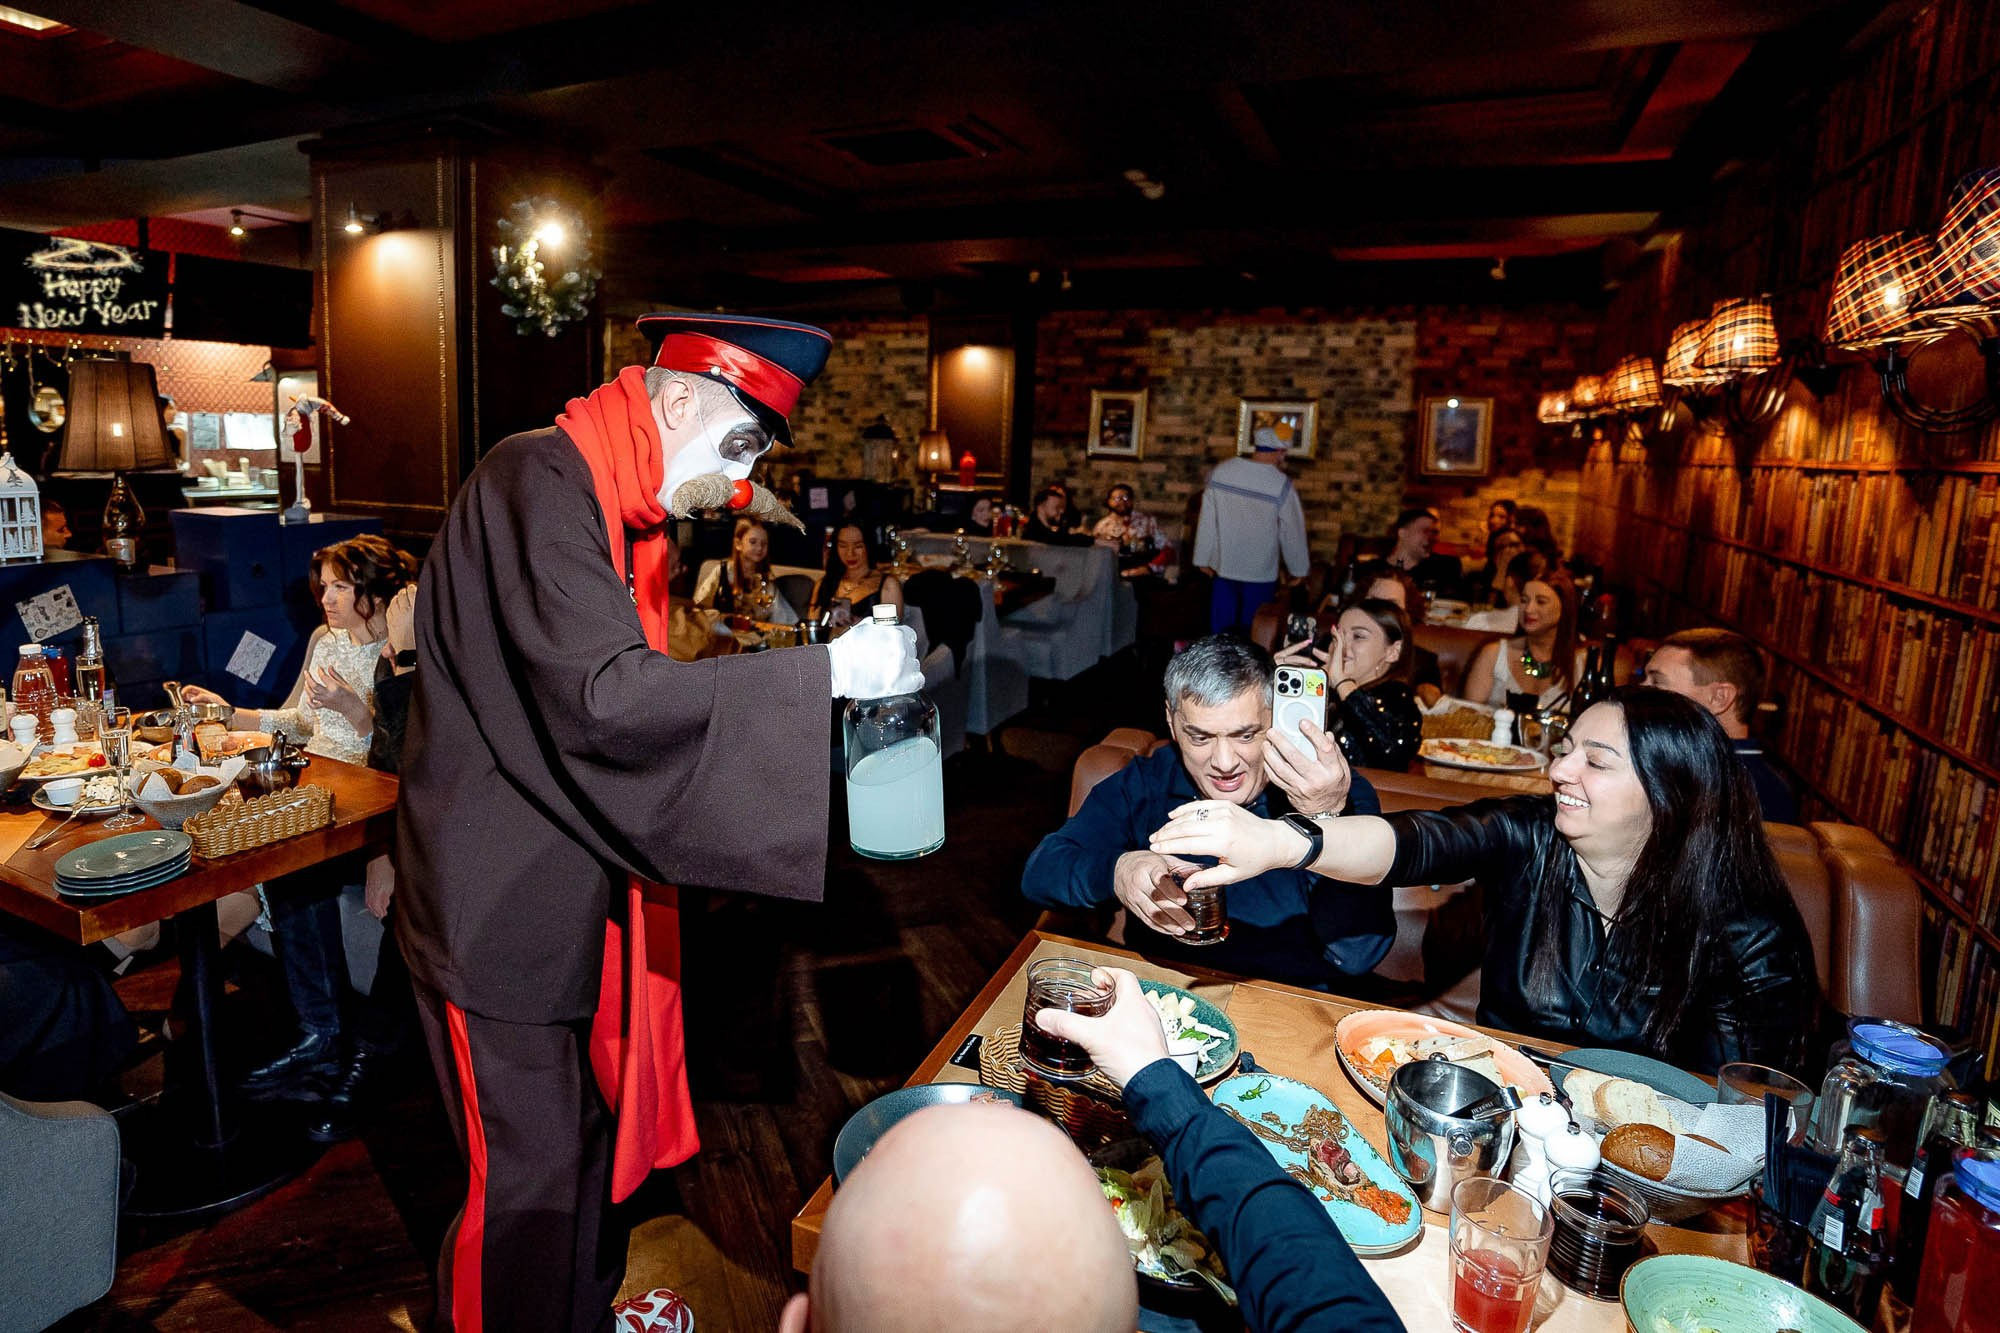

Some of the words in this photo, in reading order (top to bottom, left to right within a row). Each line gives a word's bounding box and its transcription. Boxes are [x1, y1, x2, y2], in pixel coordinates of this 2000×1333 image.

[43, 272, 122, 304] Happy
[18, 302, 88, 329] New
[92, 300, 159, 326] Year
